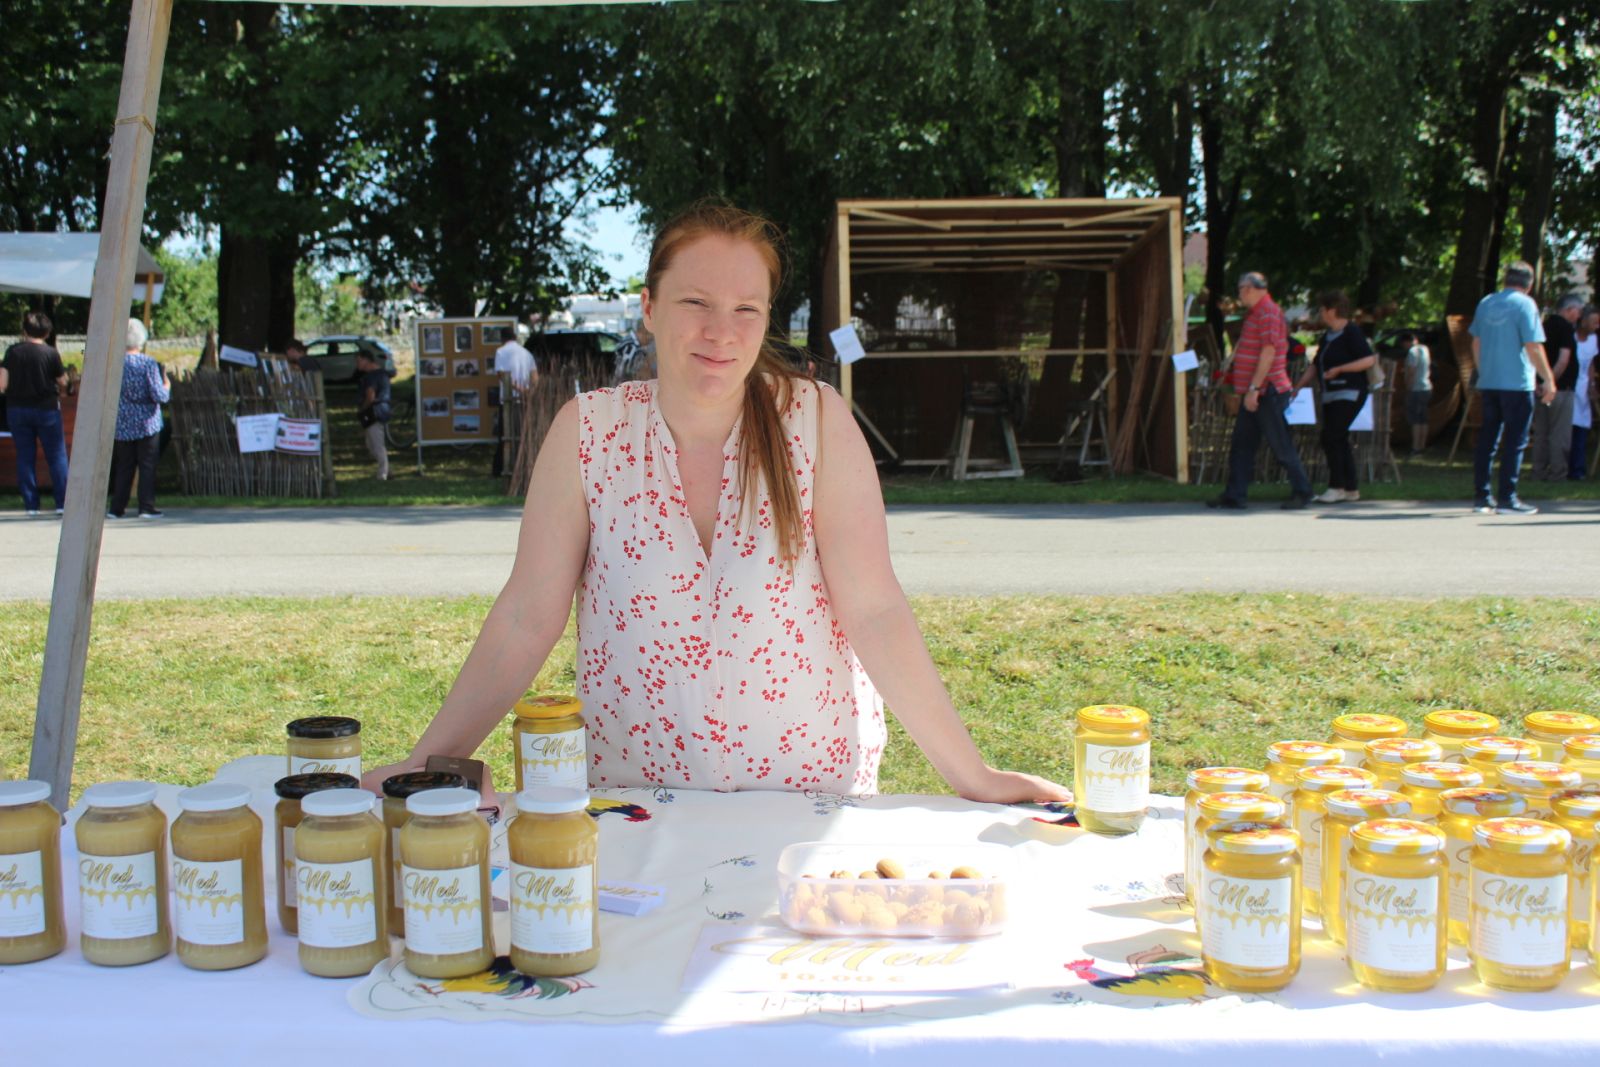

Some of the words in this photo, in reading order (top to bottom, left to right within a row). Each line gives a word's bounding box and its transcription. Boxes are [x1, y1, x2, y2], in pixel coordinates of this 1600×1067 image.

[531, 736, 577, 758] Med
[80, 859, 134, 888] Med
[173, 862, 219, 893] Med
[298, 866, 352, 897] Med
[405, 871, 459, 902] Med
[515, 871, 575, 902] Med
[1209, 878, 1270, 912] Med
[1354, 878, 1418, 912] Med
[1482, 879, 1550, 911] Med
[710, 936, 975, 971] Med
